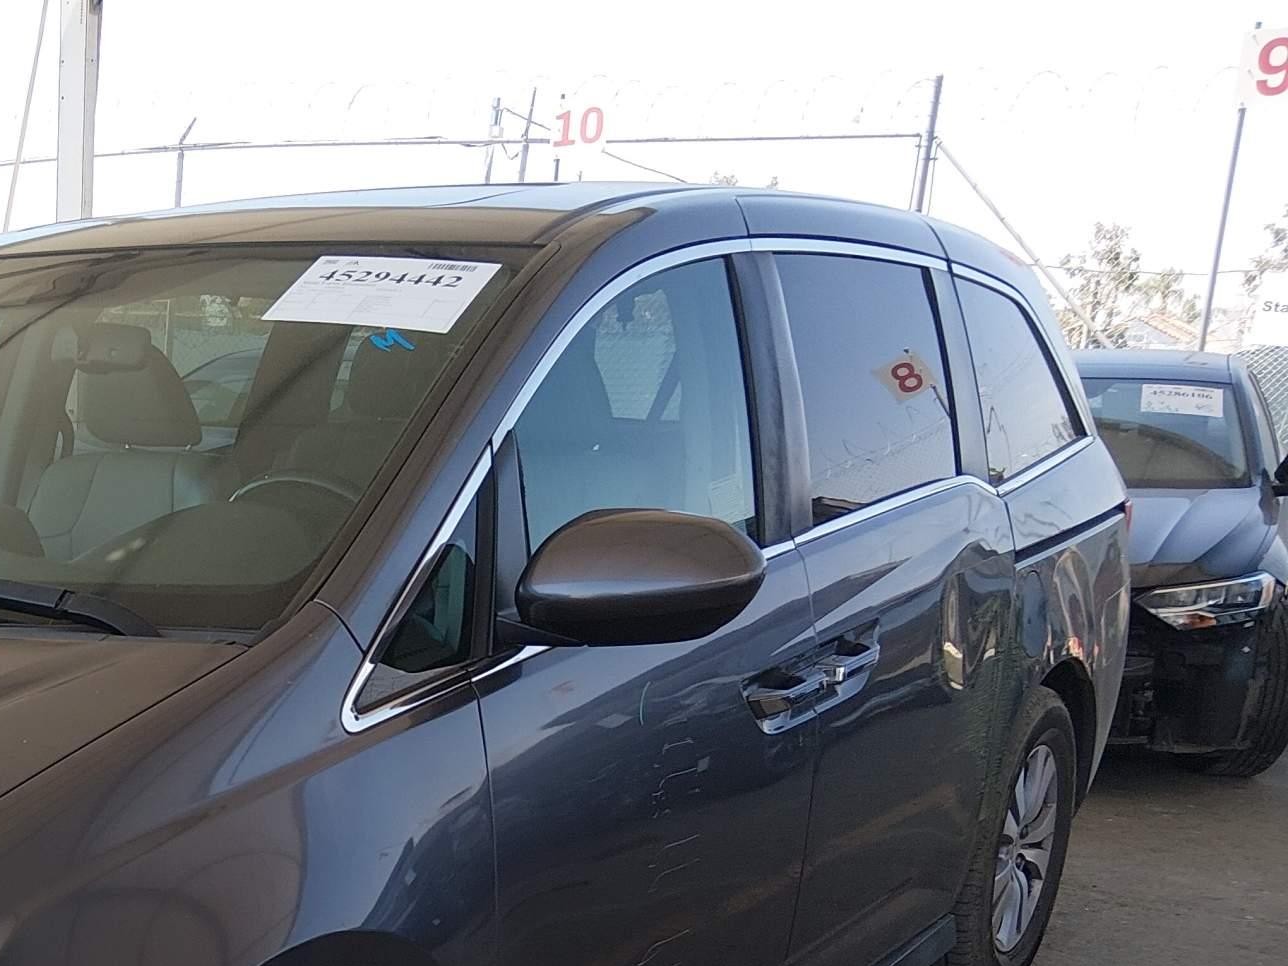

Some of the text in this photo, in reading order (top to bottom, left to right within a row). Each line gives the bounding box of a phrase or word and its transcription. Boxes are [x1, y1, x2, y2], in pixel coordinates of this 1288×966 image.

[1256, 37, 1288, 96] 9
[553, 107, 604, 147] 10
[319, 269, 463, 288] 45294442
